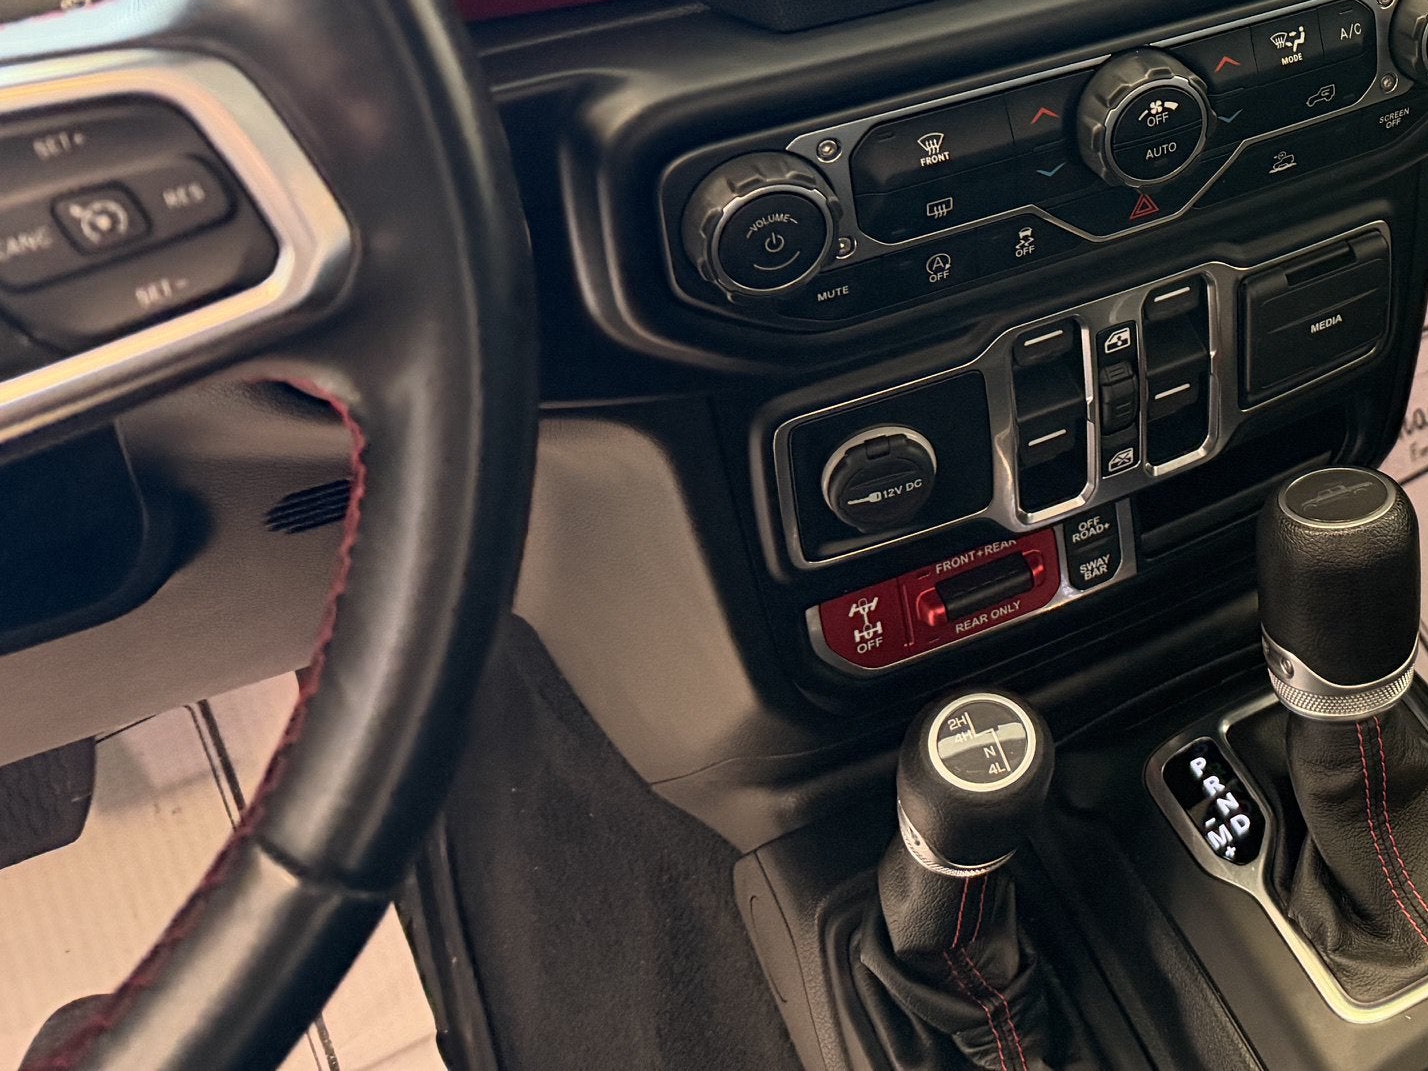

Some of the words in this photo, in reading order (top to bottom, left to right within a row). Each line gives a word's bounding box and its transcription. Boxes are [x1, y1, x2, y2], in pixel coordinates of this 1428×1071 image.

[1339, 22, 1363, 42] A/C
[1280, 52, 1304, 66] MODE
[1146, 112, 1170, 128] OFF
[1379, 107, 1410, 124] SCREEN
[1385, 117, 1402, 129] OFF
[919, 151, 951, 167] FRONT
[1145, 141, 1177, 160] AUTO
[749, 213, 791, 232] VOLUME
[1014, 243, 1036, 258] OFF
[928, 270, 950, 284] OFF
[816, 284, 850, 302] MUTE
[1310, 313, 1343, 334] MEDIA
[882, 485, 904, 499] 12V
[904, 478, 923, 492] DC
[1071, 522, 1111, 543] ROAD+
[1077, 515, 1101, 532] OFF
[1079, 554, 1111, 574] SWAY
[1084, 564, 1108, 581] BAR
[955, 613, 988, 633] REAR
[990, 600, 1021, 620] ONLY
[856, 636, 884, 654] OFF
[947, 715, 967, 731] 2H
[954, 729, 973, 744] 4H
[983, 745, 997, 759] N
[988, 762, 1006, 775] 4L
[1189, 756, 1207, 779] P
[1203, 775, 1226, 798] R
[1216, 791, 1240, 817] N
[1229, 813, 1251, 837] D
[1206, 823, 1233, 850] M
